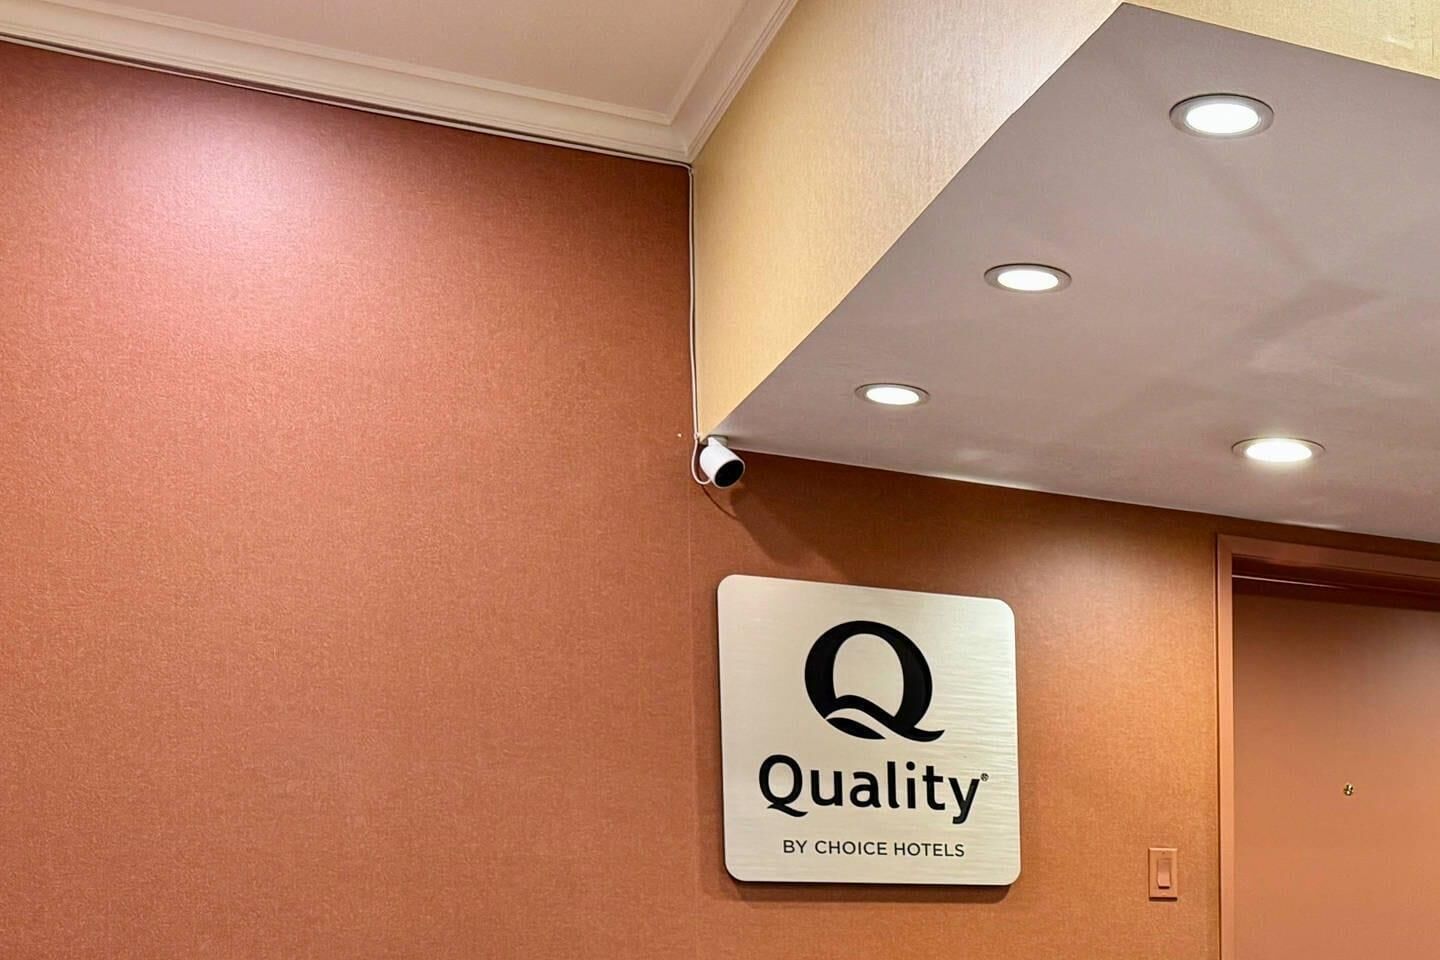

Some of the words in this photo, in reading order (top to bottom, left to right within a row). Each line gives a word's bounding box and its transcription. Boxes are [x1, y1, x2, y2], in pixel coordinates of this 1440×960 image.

[804, 620, 945, 742] Q
[758, 754, 981, 824] Quality
[783, 839, 808, 854] BY
[815, 840, 888, 856] CHOICE
[894, 842, 965, 857] HOTELS
